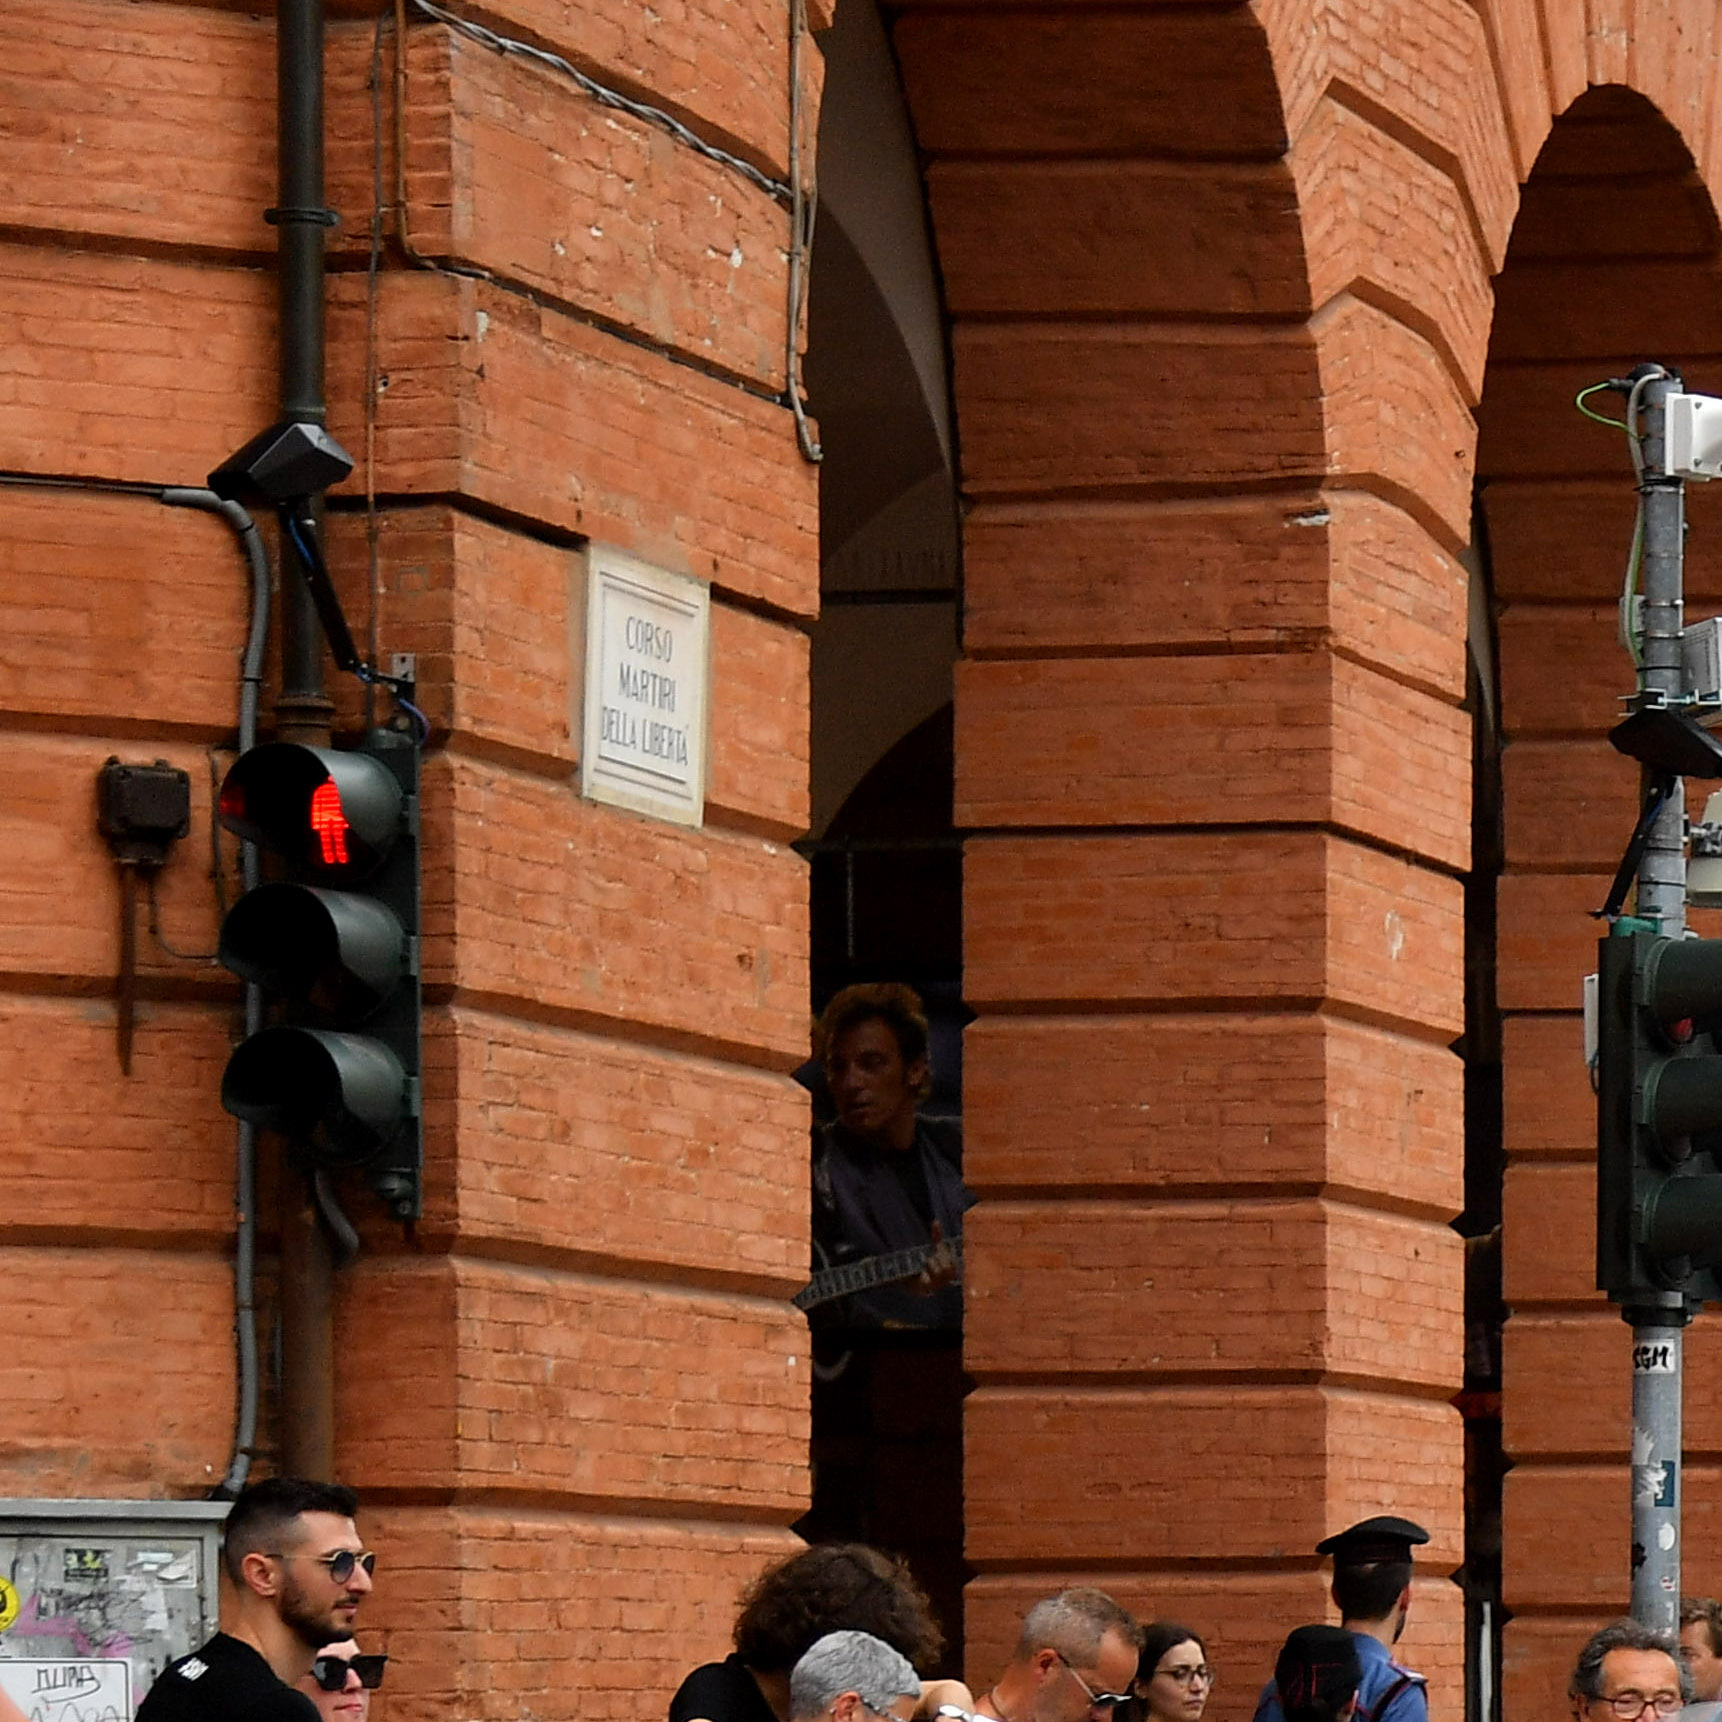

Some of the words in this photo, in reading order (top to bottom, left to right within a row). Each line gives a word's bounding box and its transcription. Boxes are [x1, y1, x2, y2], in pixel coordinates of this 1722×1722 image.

[625, 615, 673, 663] CORSO
[619, 662, 676, 712] MARTIRI
[602, 706, 637, 750] DELLA
